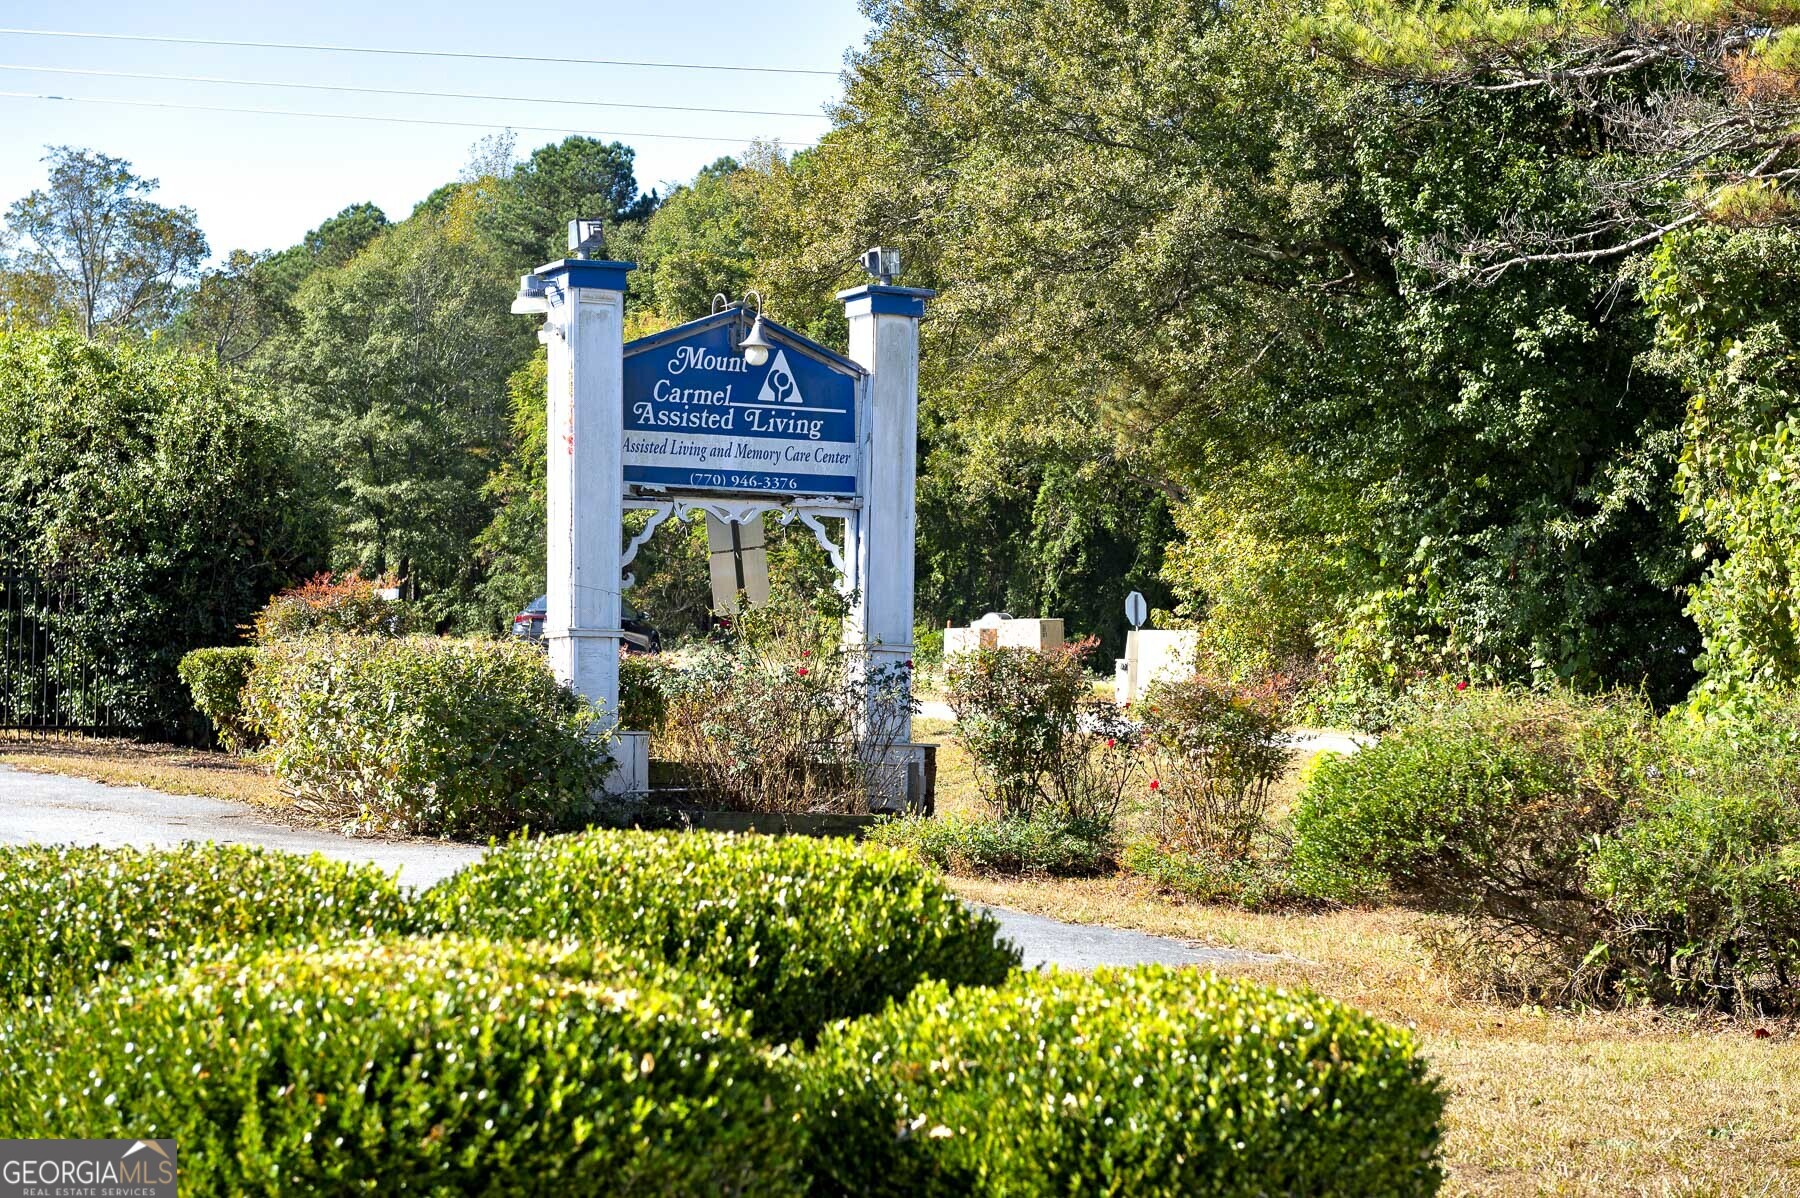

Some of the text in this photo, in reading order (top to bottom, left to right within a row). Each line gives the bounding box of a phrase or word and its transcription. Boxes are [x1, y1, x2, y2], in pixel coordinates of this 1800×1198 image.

[668, 346, 748, 374] Mount
[653, 379, 732, 405] Carmel
[633, 402, 824, 439] Assisted Living
[622, 437, 851, 465] Assisted Living and Memory Care Center
[690, 472, 797, 489] (770) 946-3376
